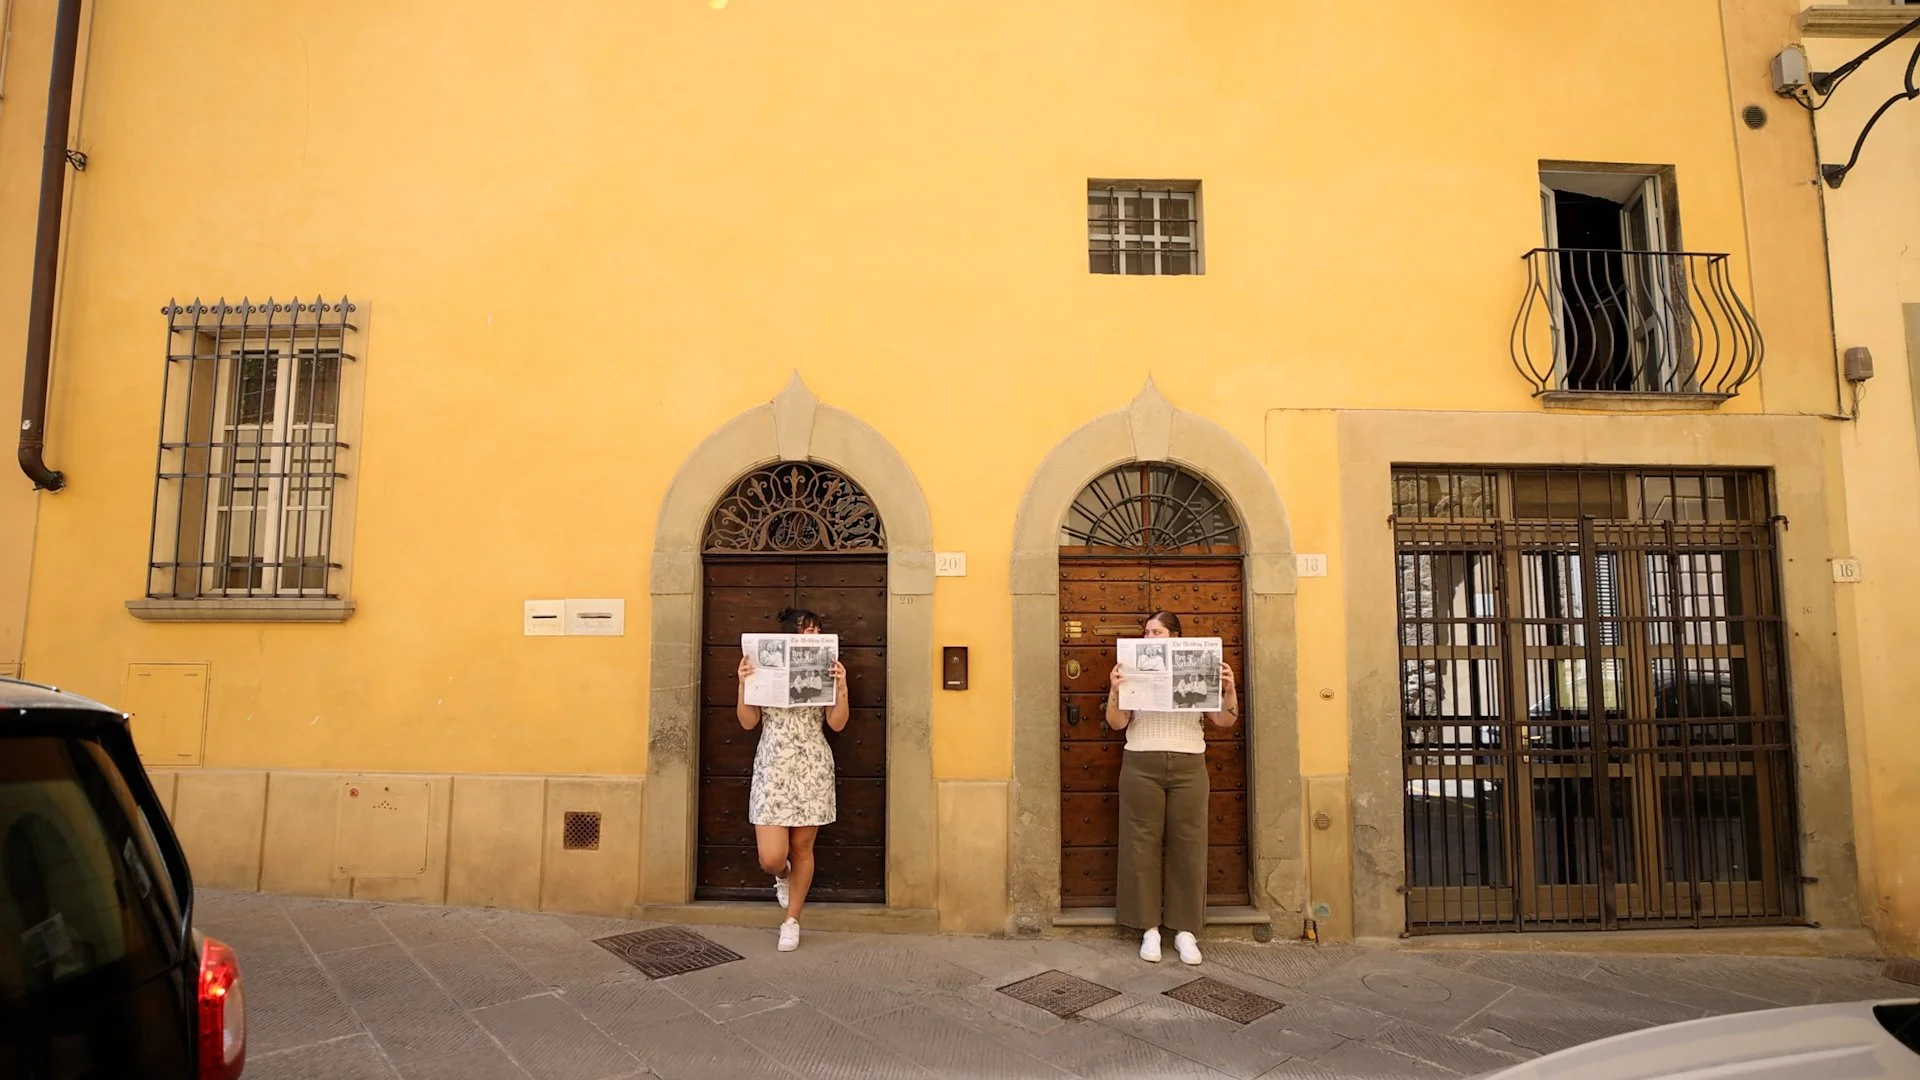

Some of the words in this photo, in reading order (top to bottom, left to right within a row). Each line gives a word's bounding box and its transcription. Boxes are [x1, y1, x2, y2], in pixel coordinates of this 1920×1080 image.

[940, 558, 958, 572] 20
[1304, 558, 1318, 572] 18
[1840, 564, 1853, 578] 16
[900, 596, 914, 604] 20
